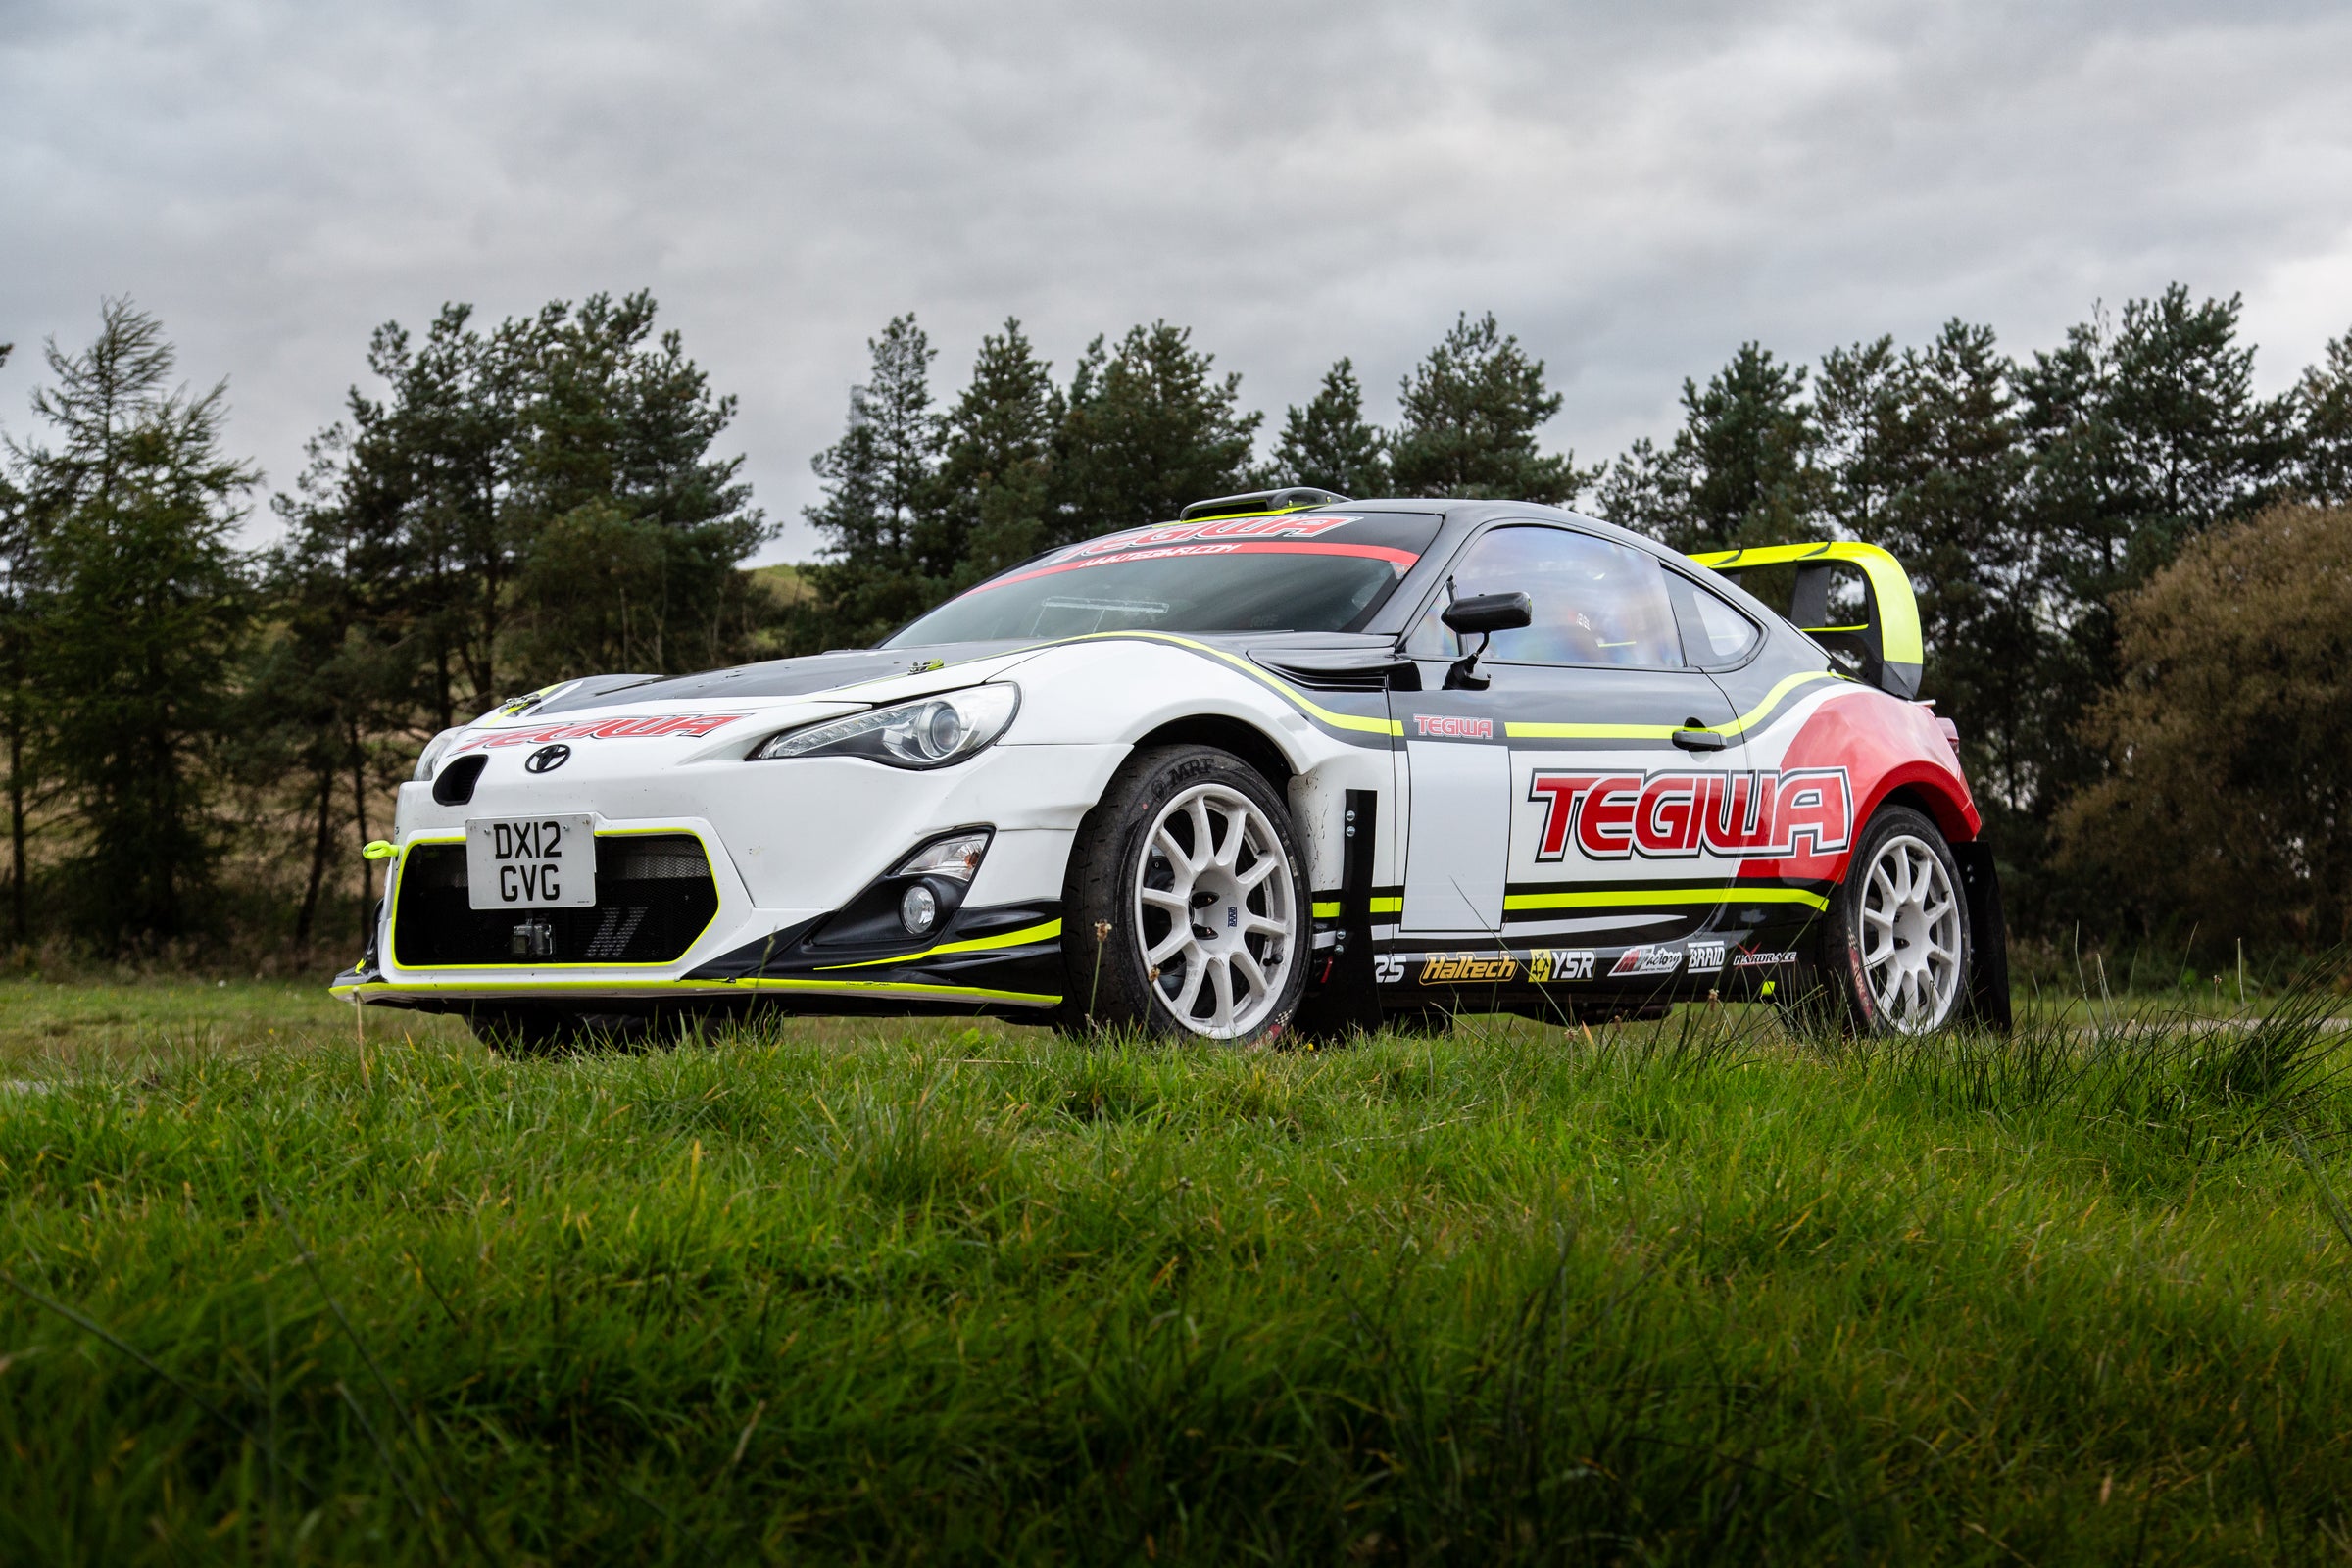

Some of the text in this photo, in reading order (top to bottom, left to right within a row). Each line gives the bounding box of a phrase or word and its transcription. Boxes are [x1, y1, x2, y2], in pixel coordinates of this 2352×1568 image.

[1413, 713, 1493, 740] TEGIWA
[1168, 758, 1215, 787] MRF
[1529, 768, 1852, 862] TEGIWA
[493, 821, 562, 859] DX12
[500, 864, 560, 902] GVG
[1421, 954, 1517, 980] Haltech
[1551, 951, 1595, 979] YSR
[1688, 947, 1725, 969] BRAID
[1734, 952, 1796, 966] HARDRACE
